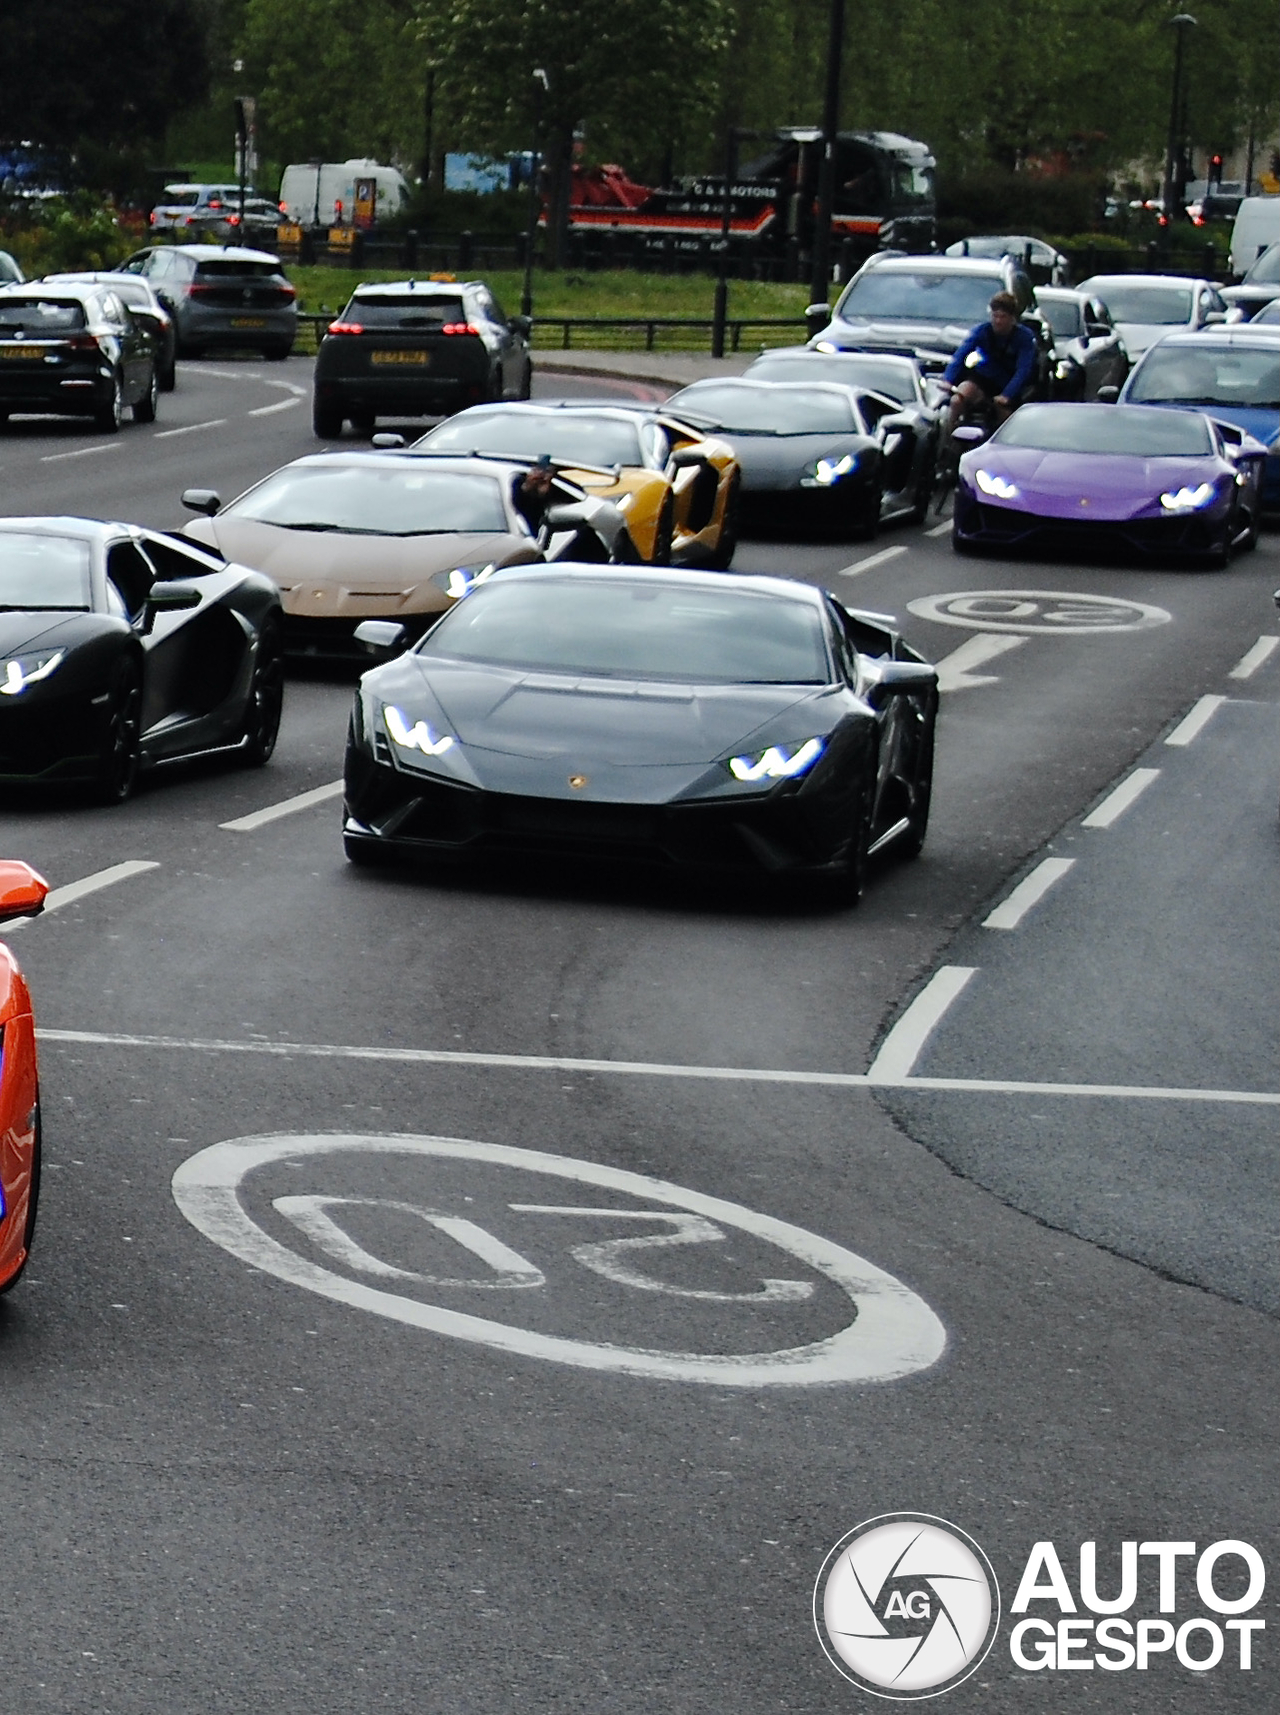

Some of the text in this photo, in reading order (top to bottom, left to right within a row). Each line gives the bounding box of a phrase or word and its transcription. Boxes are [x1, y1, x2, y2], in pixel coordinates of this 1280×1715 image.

[729, 185, 777, 198] MOTORS
[948, 599, 1134, 625] 20
[272, 1195, 815, 1302] 20
